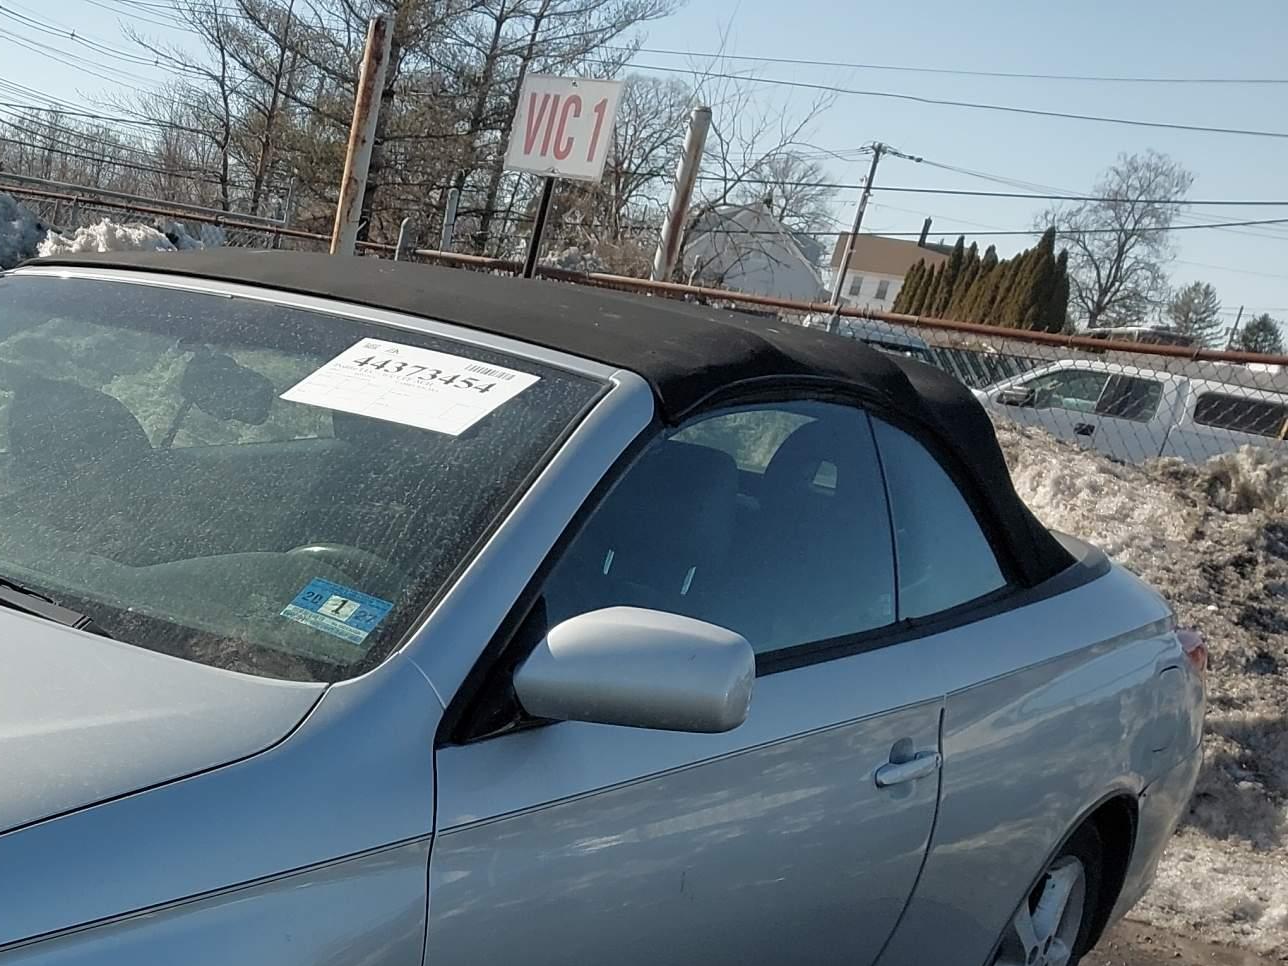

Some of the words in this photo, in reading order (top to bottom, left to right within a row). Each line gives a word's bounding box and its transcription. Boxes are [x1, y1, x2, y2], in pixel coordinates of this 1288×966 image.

[523, 92, 582, 160] VIC
[587, 98, 608, 162] 1
[353, 355, 497, 394] 44373454
[330, 599, 349, 616] 1
